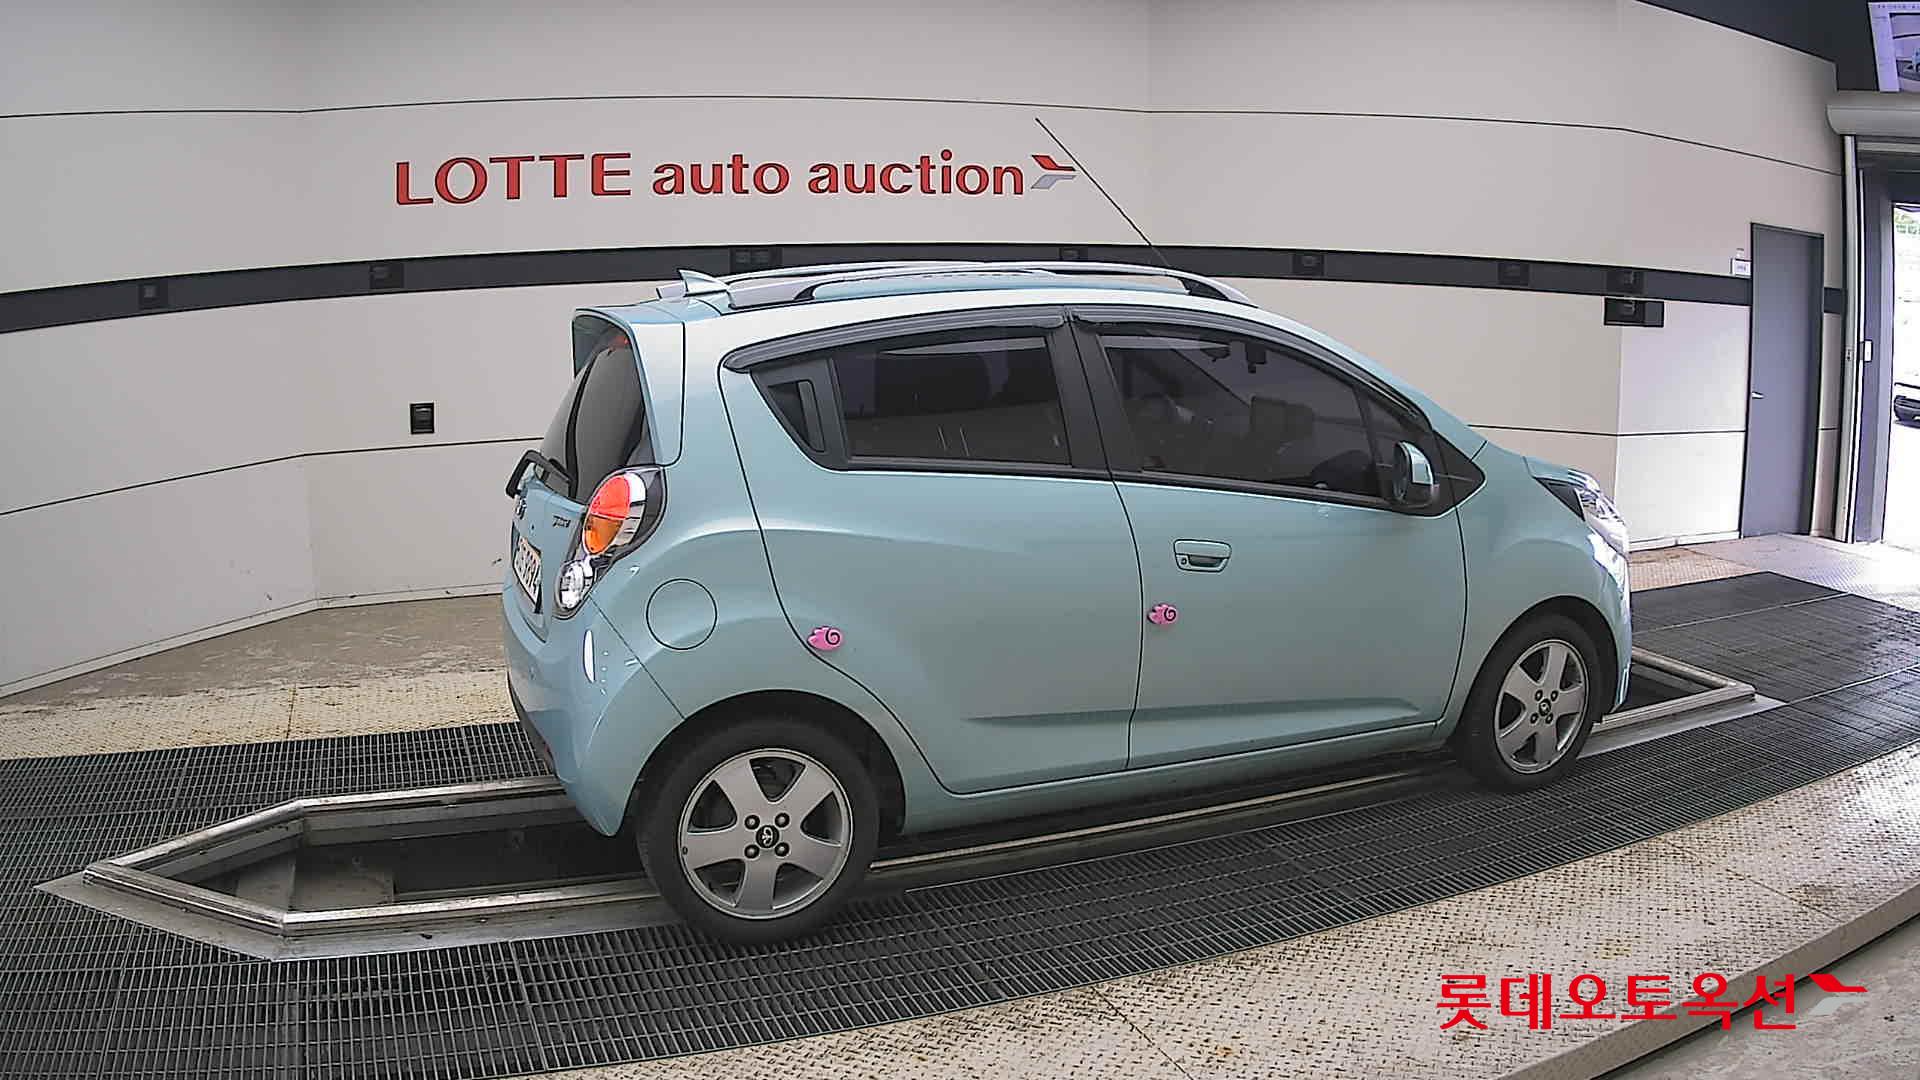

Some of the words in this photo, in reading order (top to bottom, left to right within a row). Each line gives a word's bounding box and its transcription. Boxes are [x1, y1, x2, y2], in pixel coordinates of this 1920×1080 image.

[396, 152, 631, 206] LOTTE
[652, 153, 790, 196] auto
[807, 149, 1024, 195] auction
